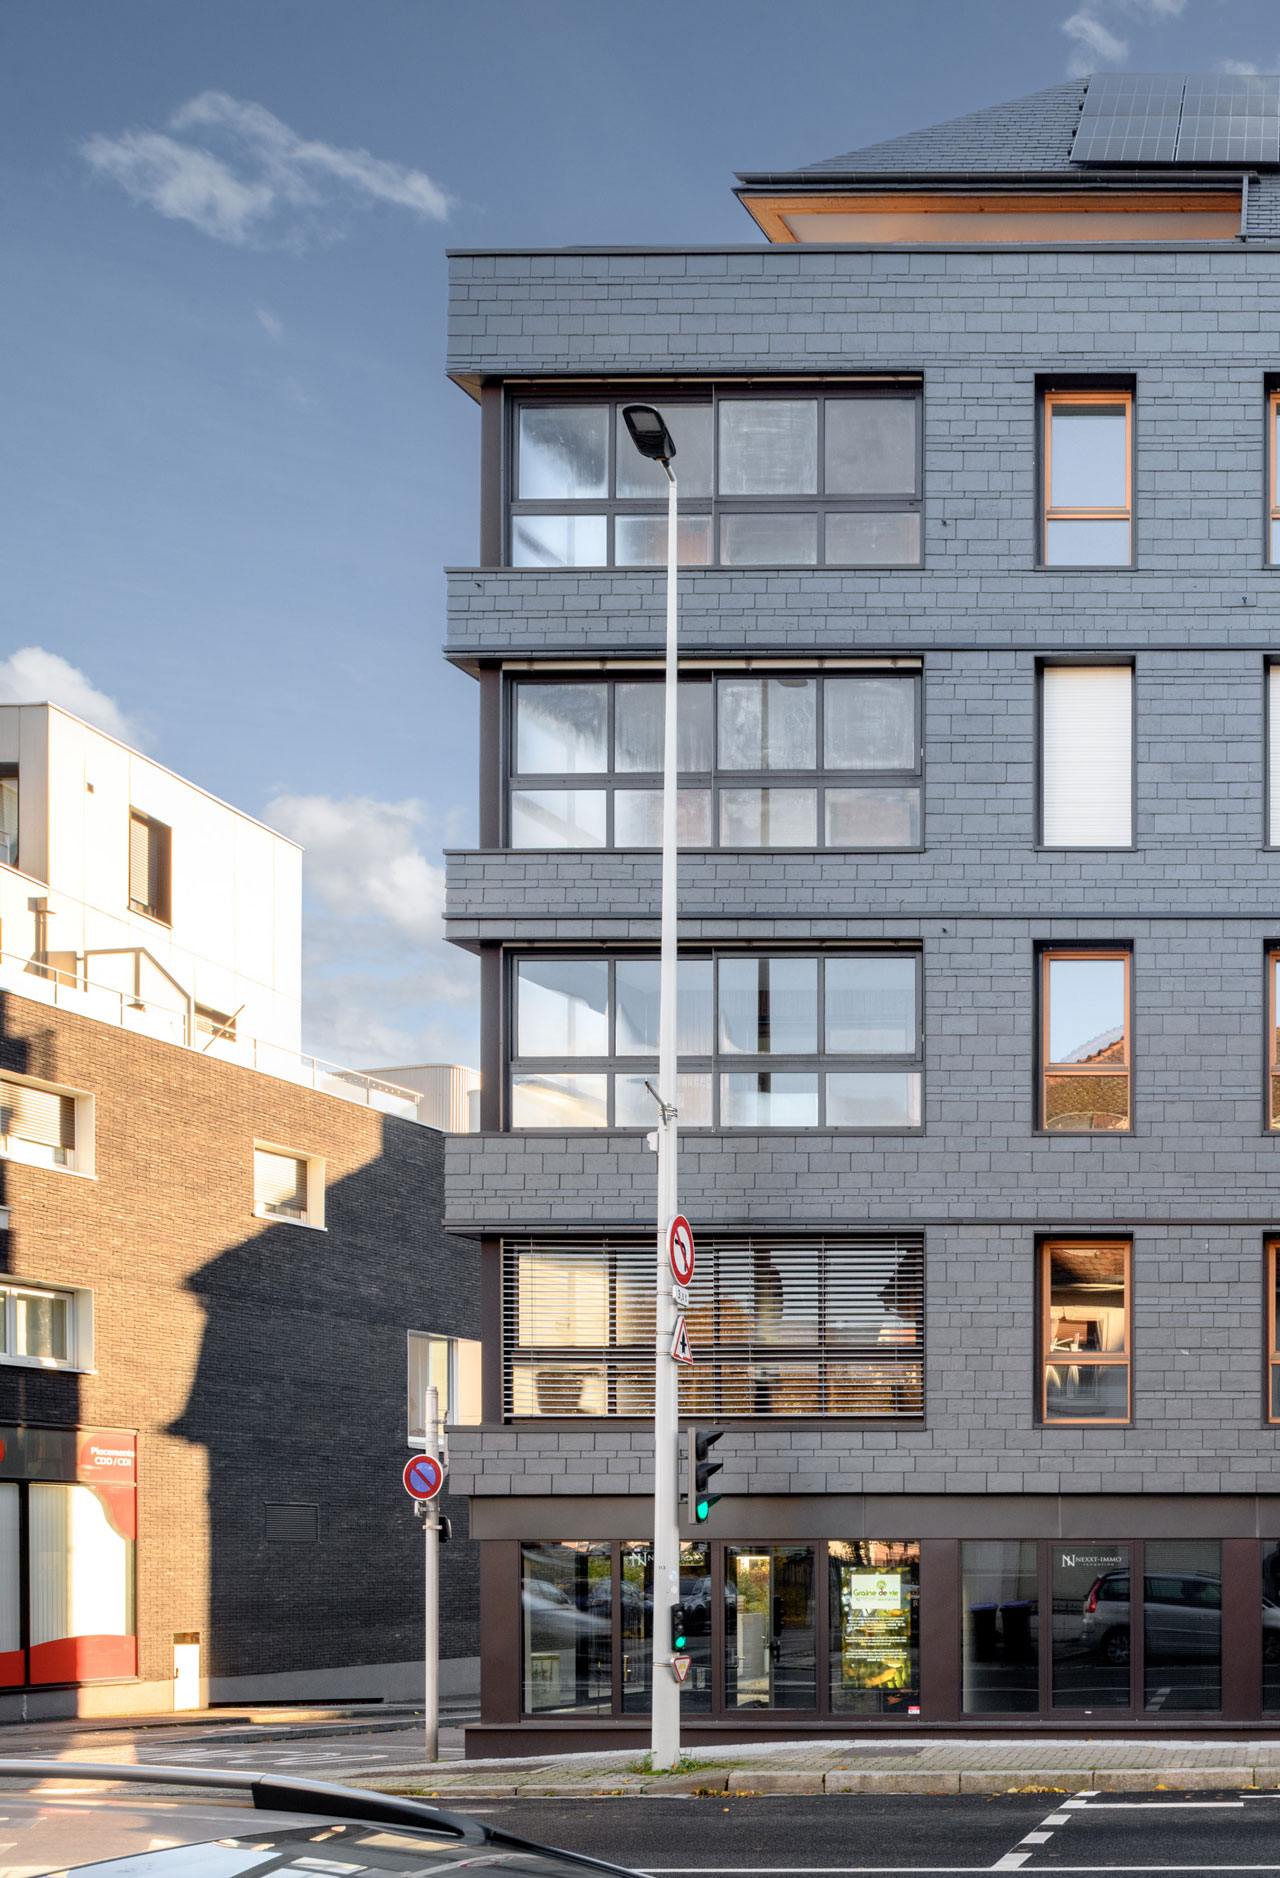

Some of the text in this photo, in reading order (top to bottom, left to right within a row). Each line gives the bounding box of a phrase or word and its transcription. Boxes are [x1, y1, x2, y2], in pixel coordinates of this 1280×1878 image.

[91, 1446, 135, 1458] Placements
[853, 1588, 876, 1597] Graine
[878, 1588, 888, 1596] de
